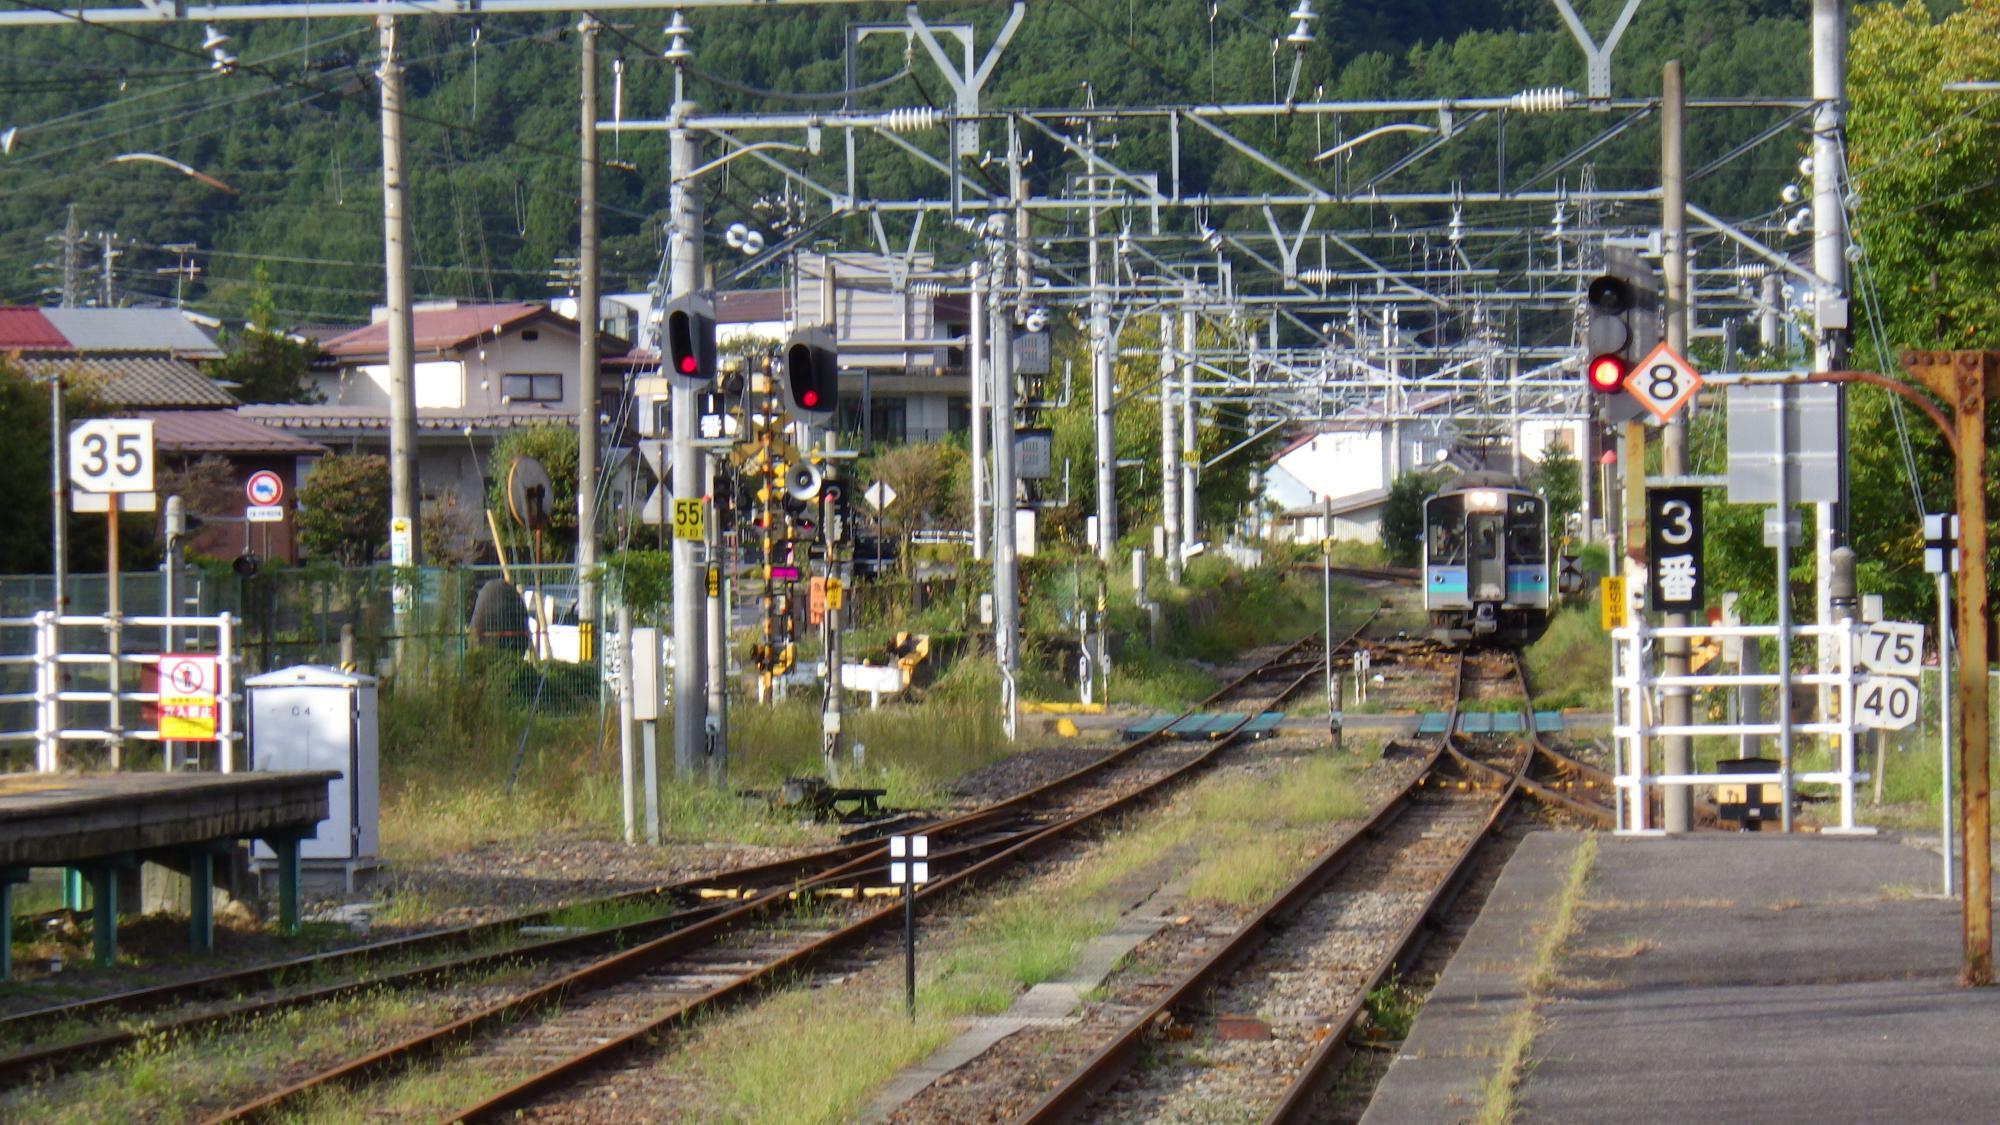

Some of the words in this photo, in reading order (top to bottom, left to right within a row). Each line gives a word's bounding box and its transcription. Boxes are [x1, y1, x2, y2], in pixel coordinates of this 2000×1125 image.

[1648, 364, 1679, 400] 8
[82, 433, 142, 477] 35
[676, 502, 703, 525] 55
[1659, 499, 1697, 602] 3番
[1870, 631, 1915, 665] 75
[1863, 686, 1910, 719] 40
